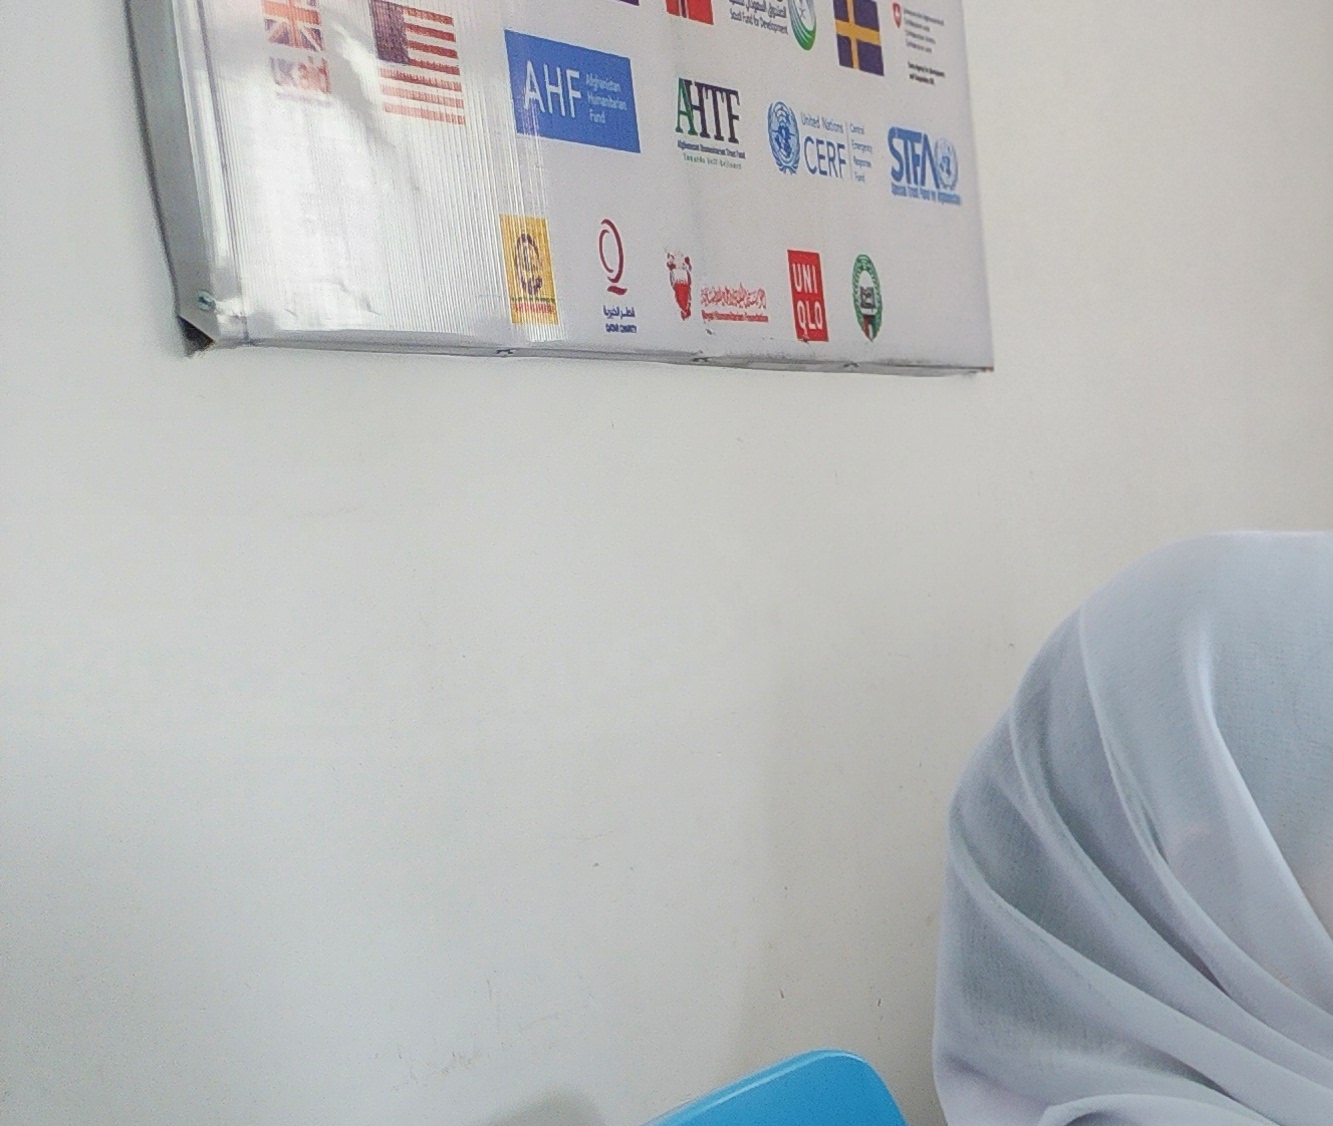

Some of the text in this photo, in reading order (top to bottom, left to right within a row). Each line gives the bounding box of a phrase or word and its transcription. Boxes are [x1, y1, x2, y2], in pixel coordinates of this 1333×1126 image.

[523, 60, 582, 118] AHF
[588, 108, 606, 124] Fund
[675, 77, 740, 144] AHTF
[801, 111, 845, 134] United Nations
[804, 135, 847, 179] CERF
[792, 263, 818, 294] UNI
[796, 300, 823, 331] QLO
